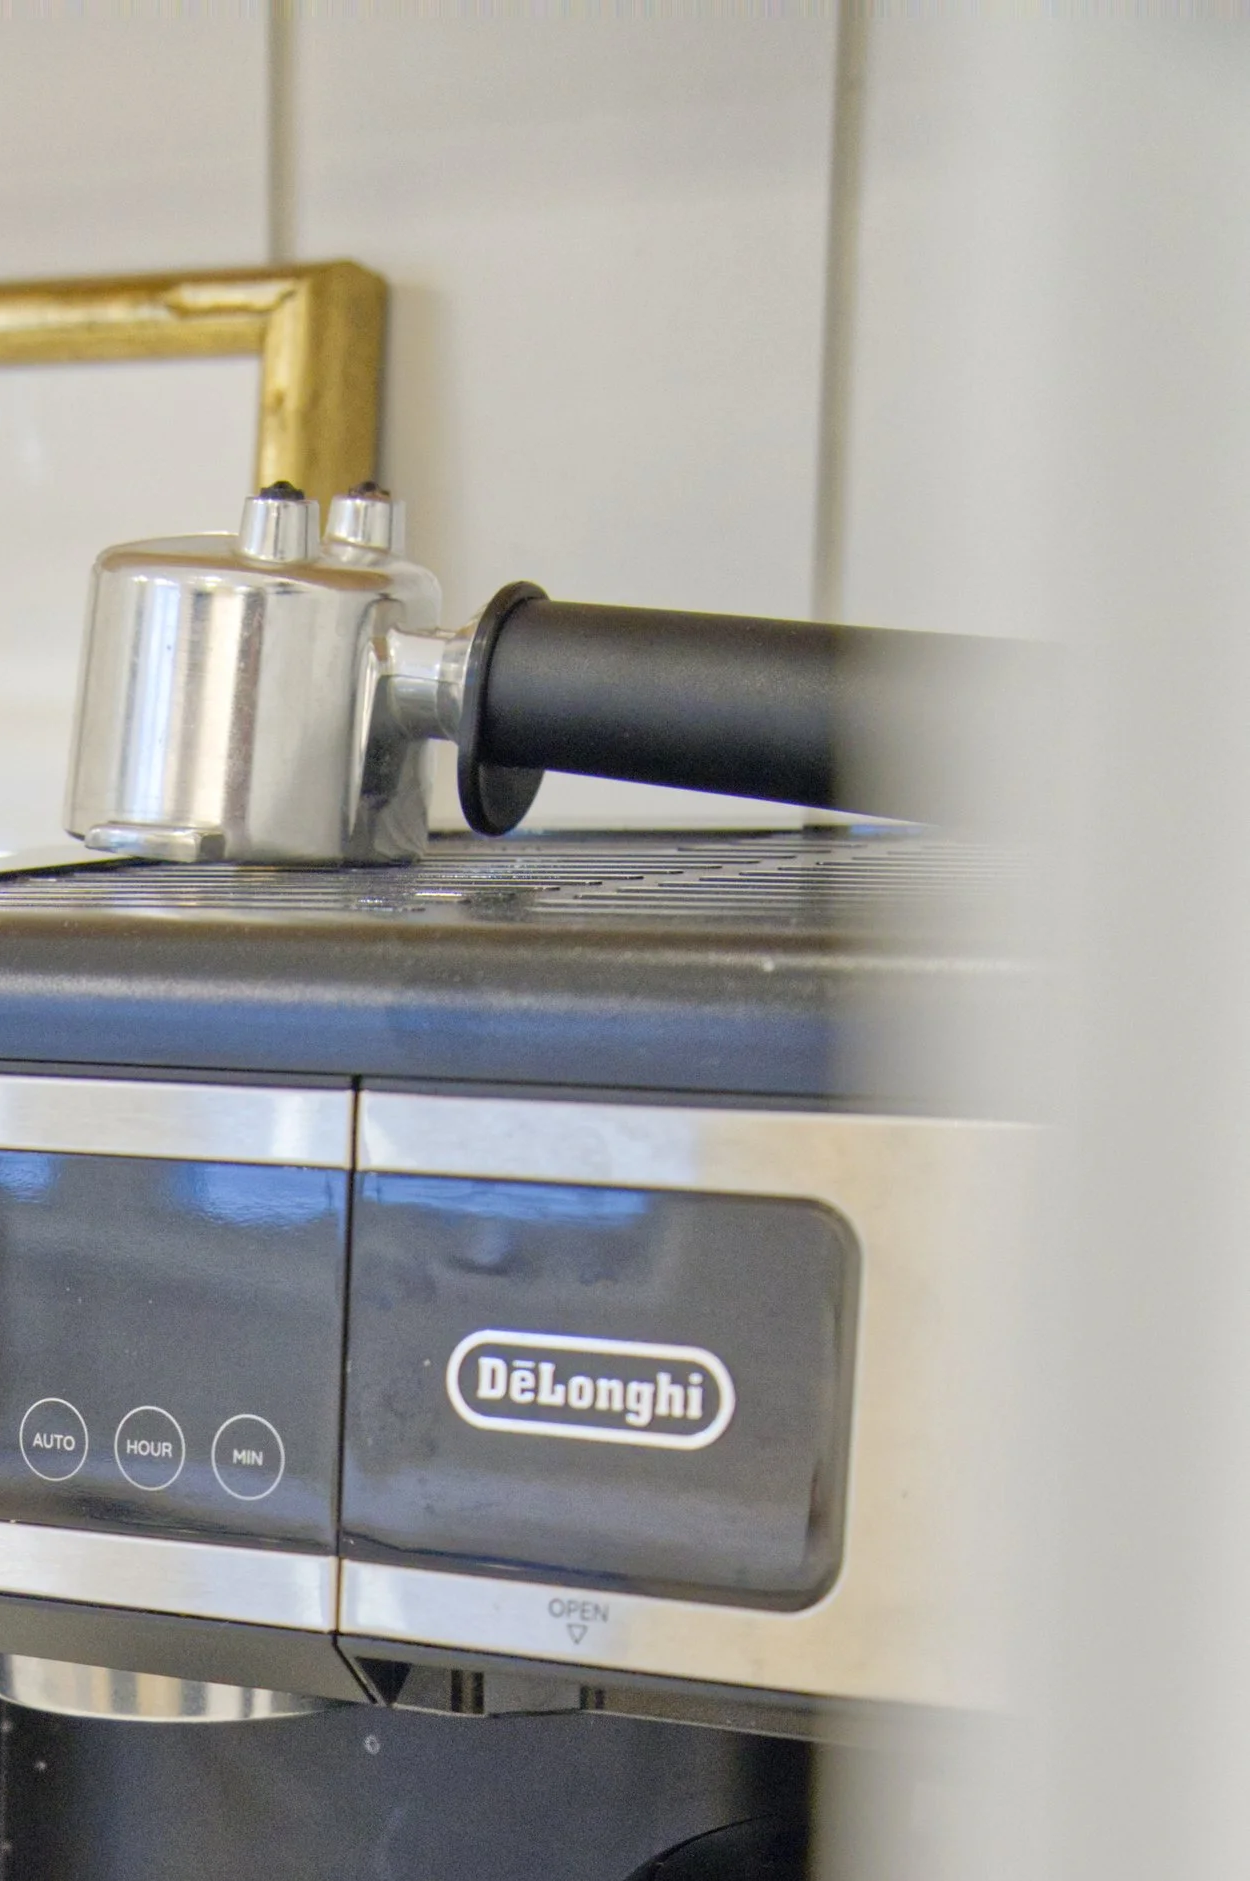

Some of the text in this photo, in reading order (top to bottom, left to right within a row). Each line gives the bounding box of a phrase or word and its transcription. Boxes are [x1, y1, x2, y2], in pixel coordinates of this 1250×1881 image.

[32, 1432, 76, 1451] AUTO
[126, 1440, 173, 1458] HOUR
[232, 1449, 264, 1467] MIN
[548, 1598, 609, 1623] OPEN
